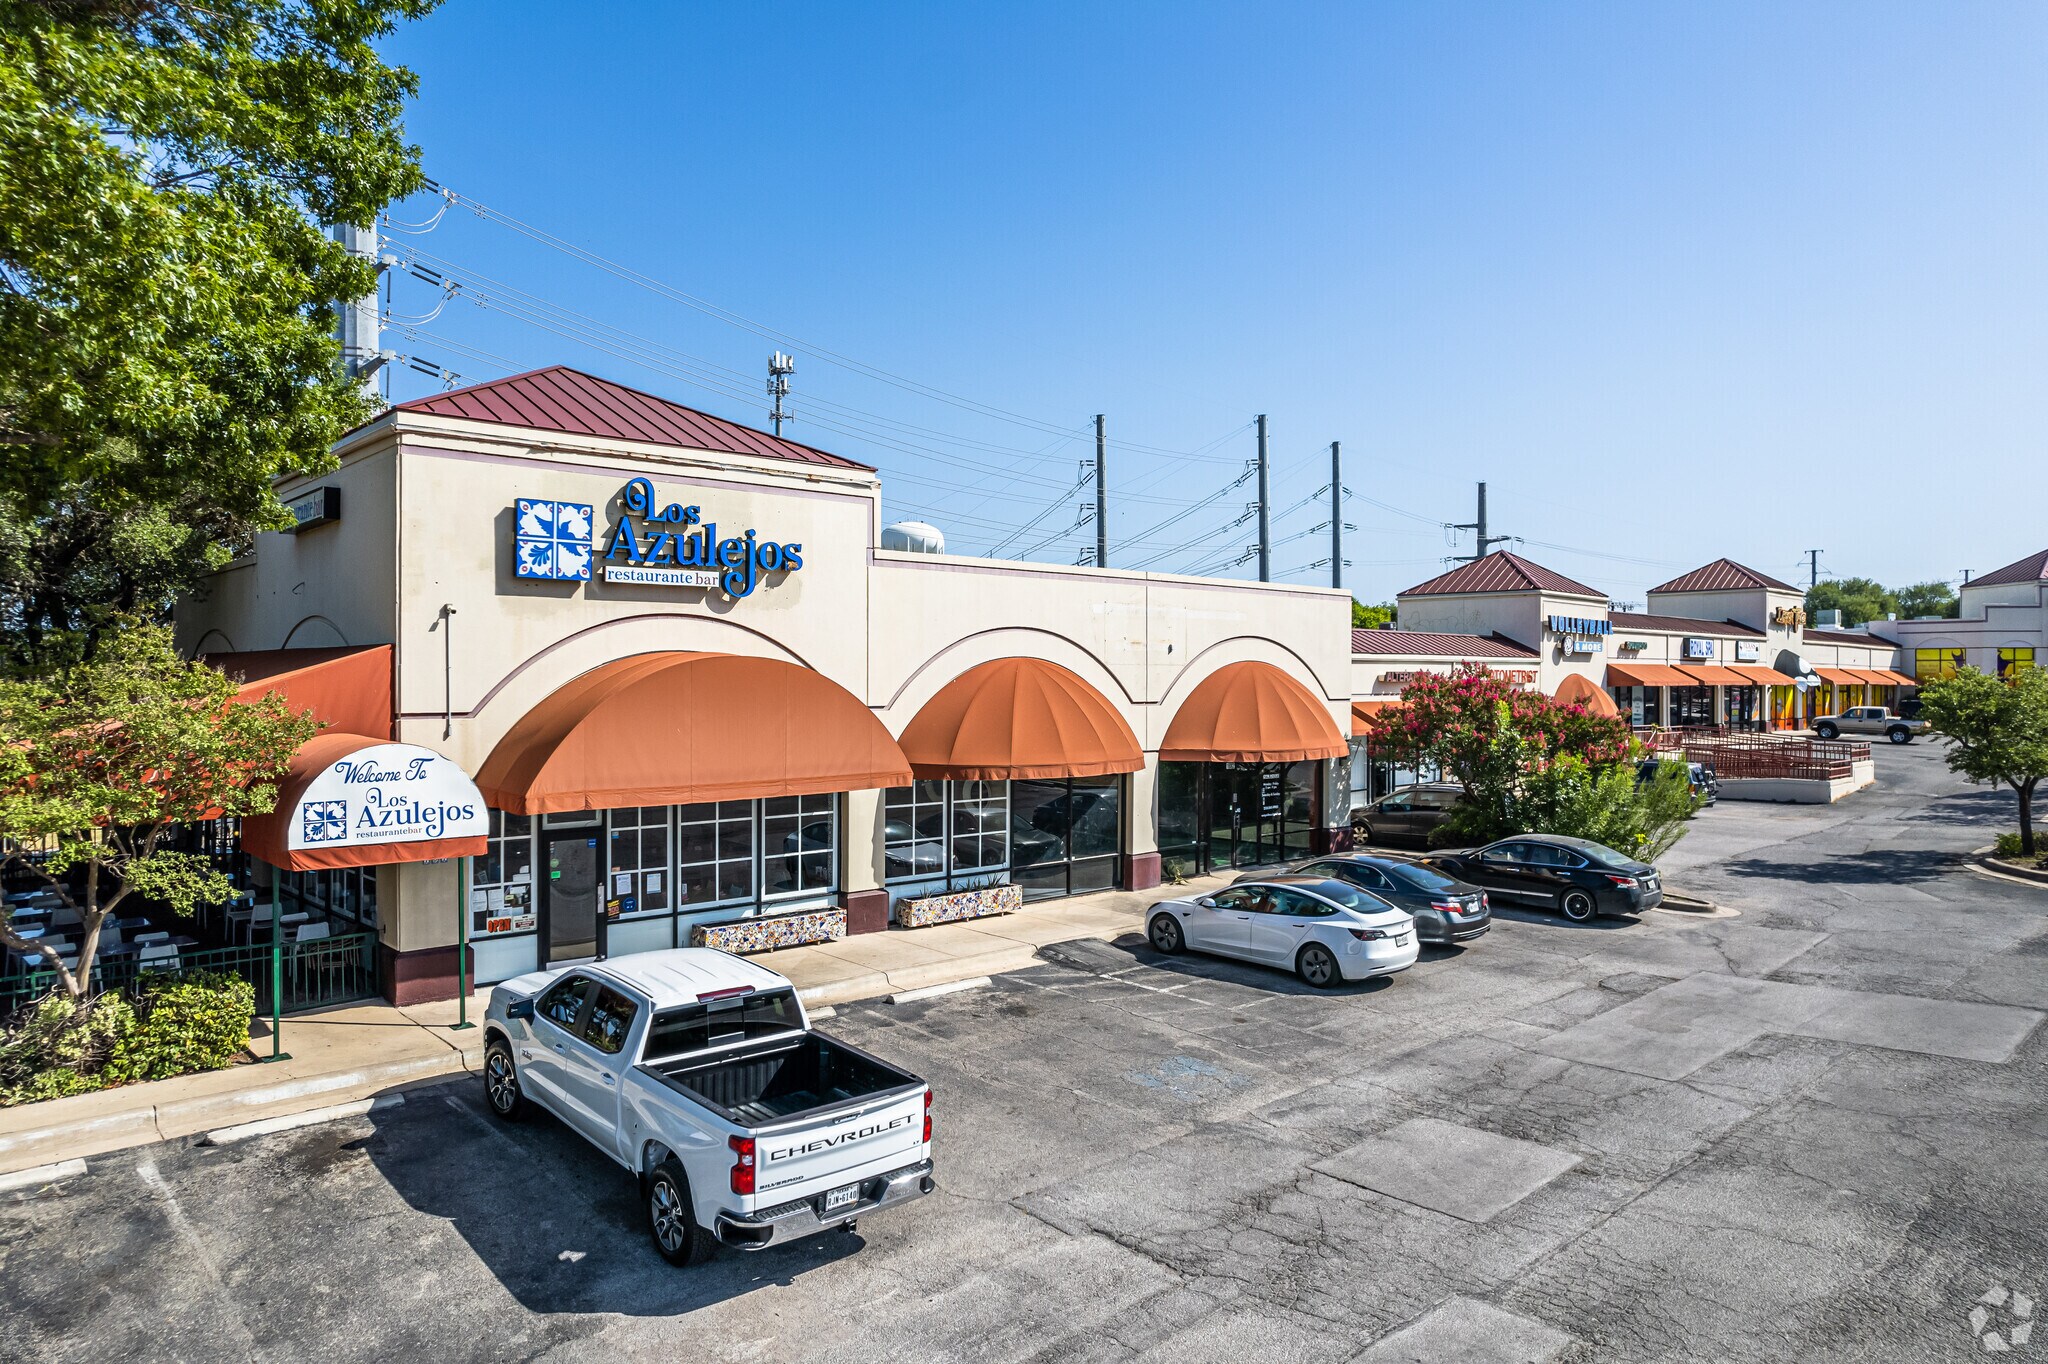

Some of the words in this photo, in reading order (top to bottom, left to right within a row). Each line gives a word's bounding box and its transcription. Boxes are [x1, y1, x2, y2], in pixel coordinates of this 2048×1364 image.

[624, 477, 700, 525] Los
[603, 516, 803, 598] Azulejos
[1549, 615, 1614, 635] VOLLEYBALL
[1581, 643, 1602, 652] MORE
[335, 761, 401, 784] Welcome
[405, 758, 435, 781] To
[366, 787, 407, 808] Los
[355, 801, 474, 838] Azulejos
[487, 918, 512, 933] OPEN
[770, 1113, 916, 1161] CHEVROLET
[759, 1175, 804, 1190] SILVERADO
